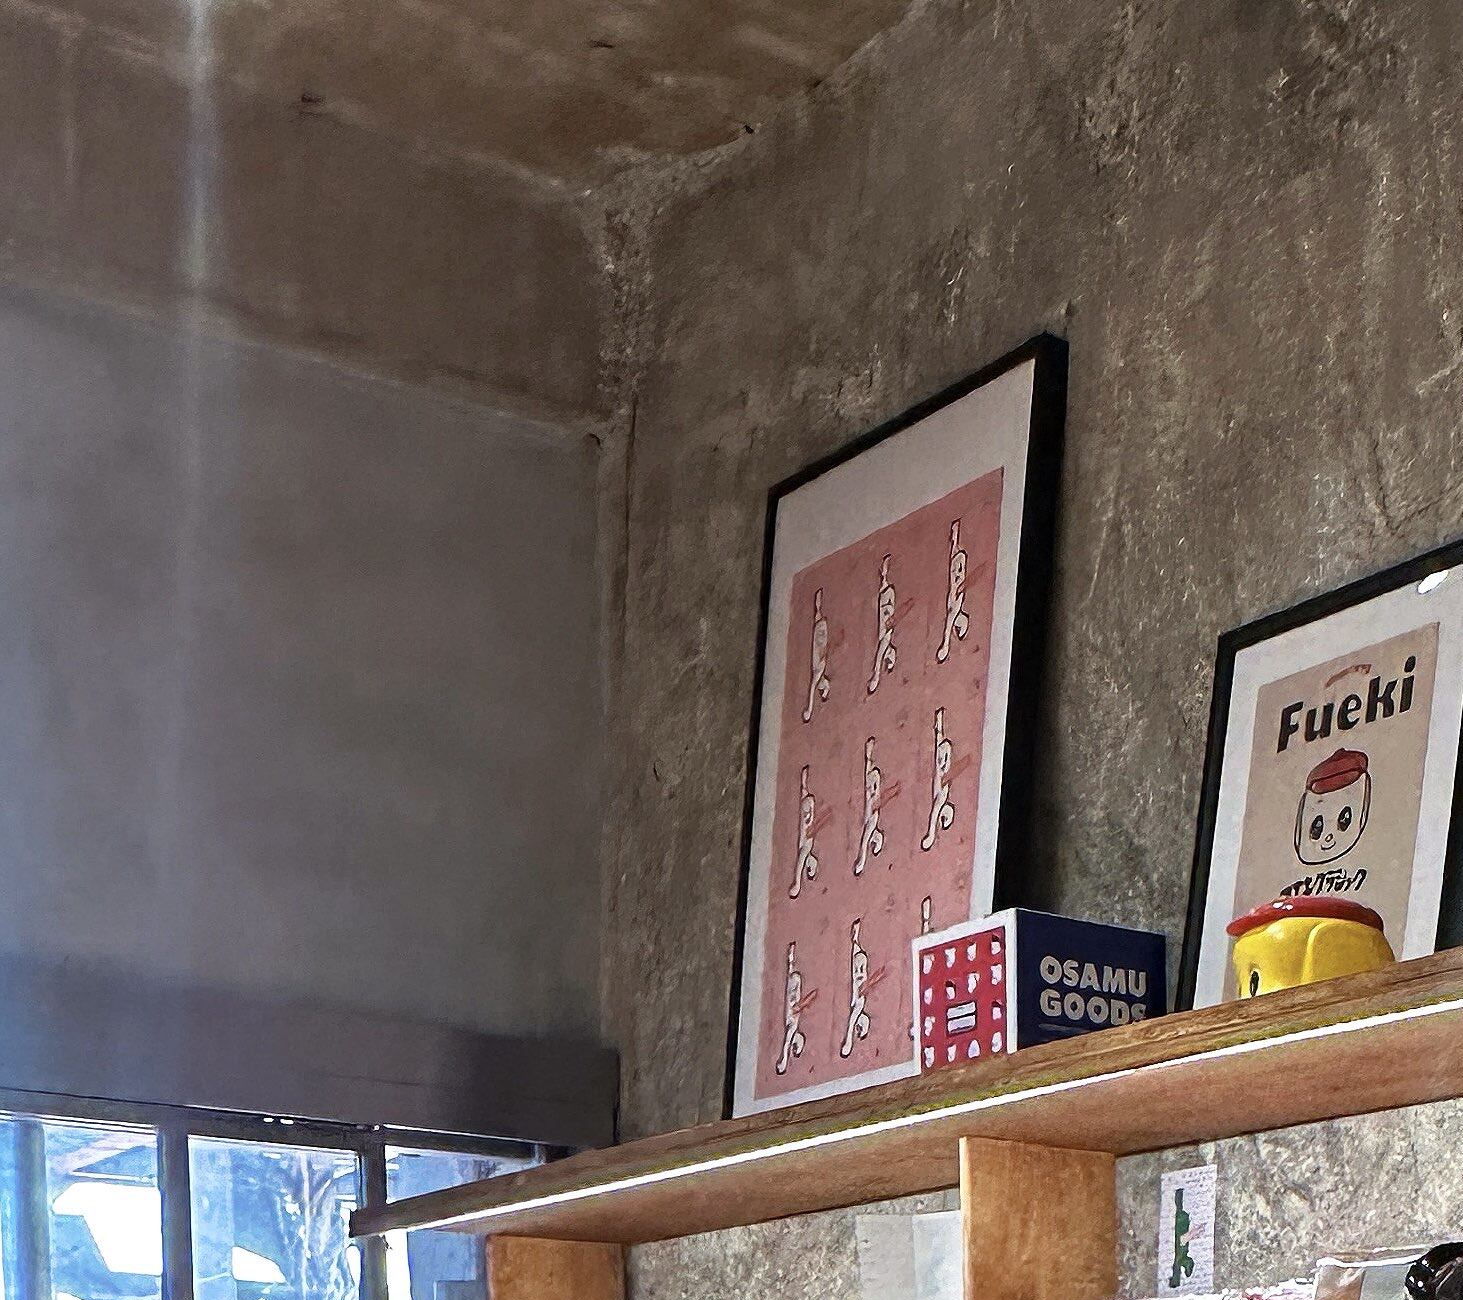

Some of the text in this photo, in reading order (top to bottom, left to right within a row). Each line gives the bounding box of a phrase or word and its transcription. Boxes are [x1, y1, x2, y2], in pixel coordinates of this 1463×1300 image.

[1276, 655, 1417, 754] Fueki
[1039, 955, 1147, 998] OSAMU
[1039, 988, 1147, 1026] GOODS
